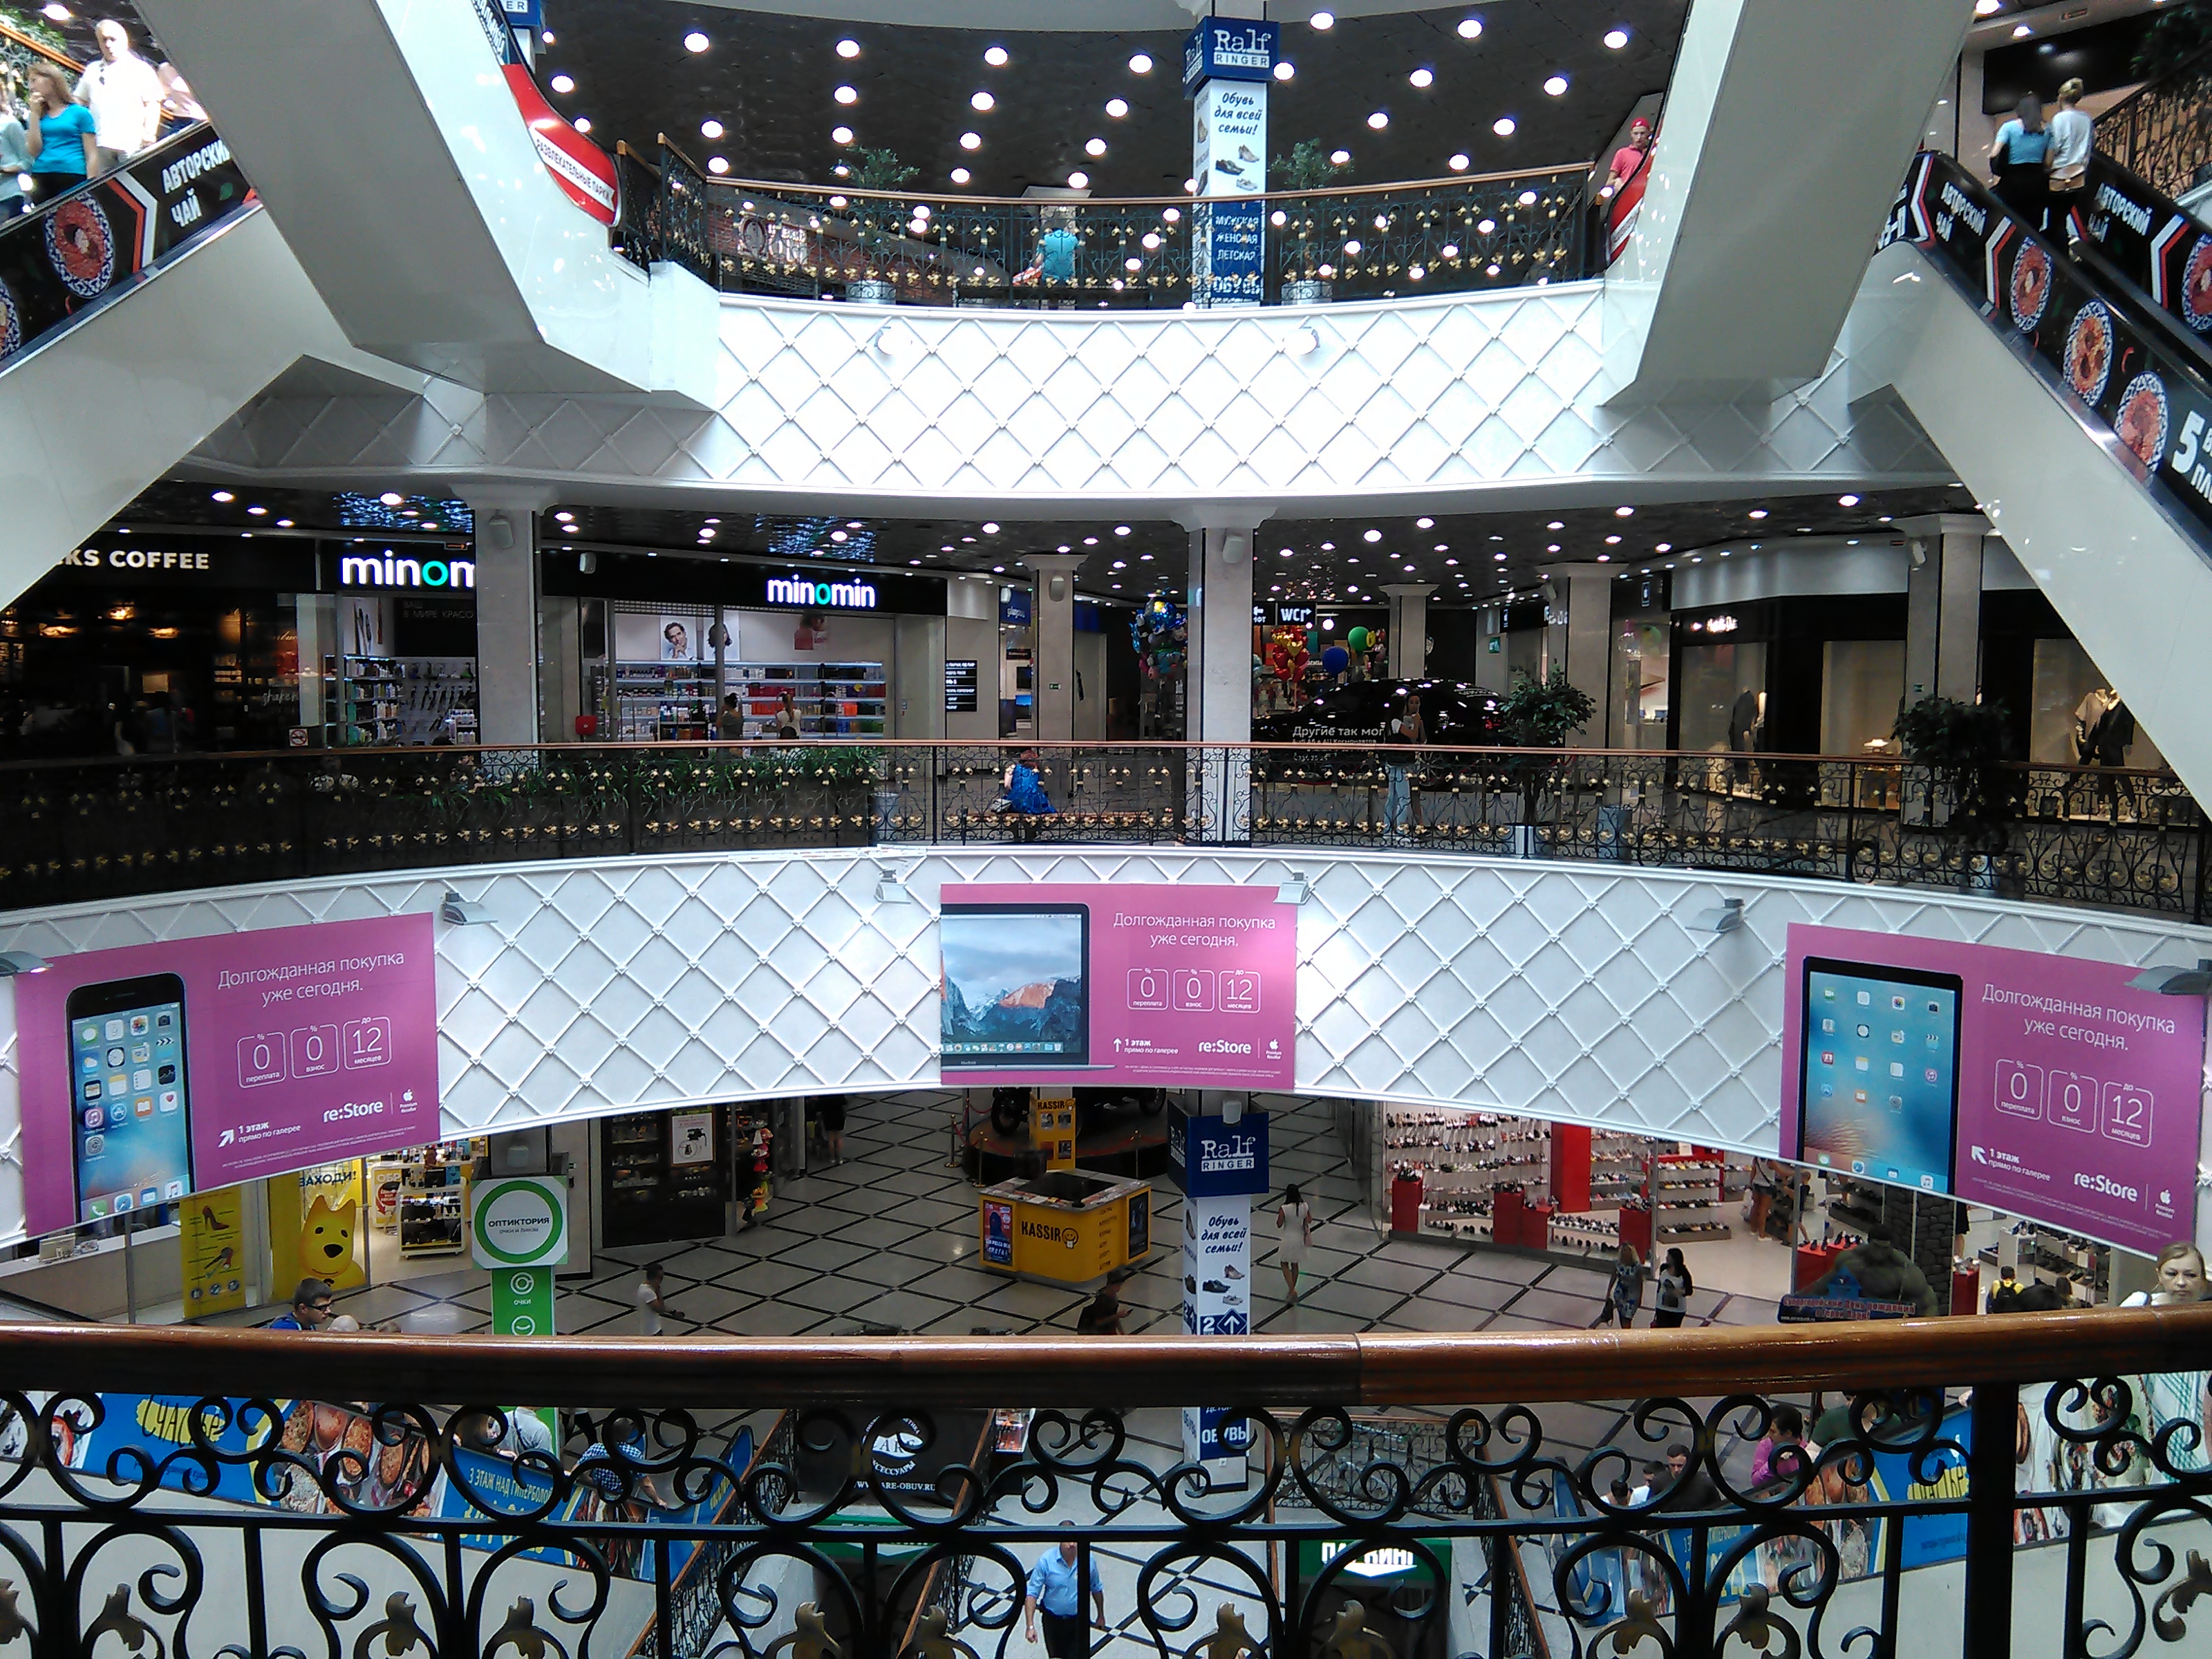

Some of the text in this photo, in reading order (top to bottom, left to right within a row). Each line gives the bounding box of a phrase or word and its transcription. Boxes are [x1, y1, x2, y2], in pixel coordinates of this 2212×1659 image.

[1214, 28, 1272, 54] Ralf
[1215, 53, 1268, 66] RINGER
[1222, 93, 1255, 106] Обувь
[1215, 106, 1263, 122] для всей
[1219, 123, 1258, 136] семьи!
[171, 187, 203, 227] ЧАЙ
[1940, 180, 1987, 236] АВТОРСКИЙ
[2094, 182, 2153, 236] АВТОРСКИЙ
[1215, 216, 1259, 227] МУЖСКАЯ
[1936, 210, 1954, 242] ЧАЙ
[2087, 213, 2110, 243] ЧАЙ
[1217, 249, 1256, 261] ДЕТСКАЯ
[2171, 410, 2206, 474] 5
[59, 549, 209, 570] KS COFFEE
[767, 574, 876, 608] minomin
[1280, 608, 1300, 621] WC
[1292, 726, 1335, 738] Другие
[1338, 728, 1358, 736] так
[1113, 912, 1276, 932] Долгожданная покупка
[1150, 934, 1239, 948] уже сегодня.
[218, 952, 404, 990] Долгожданная покупка
[261, 979, 364, 1008] уже сегодня.
[1141, 976, 1253, 1001] 0 0 12
[1982, 983, 2176, 1035] Долгожданная покупка
[361, 1016, 372, 1025] до
[1131, 1039, 1151, 1047] этаж
[2024, 1018, 2128, 1051] уже сегодня.
[253, 1027, 383, 1070] 0 0 12
[1154, 1047, 1179, 1056] галерее
[1198, 1038, 1252, 1055] re:Store
[245, 1055, 382, 1083] переплата взнос месяцев
[1038, 1100, 1065, 1110] KASSIR
[2010, 1072, 2144, 1129] 0 0 12
[323, 1100, 384, 1123] re:Store
[2000, 1100, 2141, 1141] переплата взнос месяцев
[238, 1124, 301, 1143] прямо по галерее
[245, 1121, 270, 1132] этаж
[1201, 1135, 1257, 1159] Ralf
[1203, 1159, 1253, 1170] RINGER
[1996, 1151, 2020, 1164] этаж
[299, 1170, 356, 1188] ЗАХОДИ!
[1988, 1159, 2051, 1182] прямо по галерее
[2074, 1172, 2138, 1202] re:Store
[488, 1217, 550, 1228] ОПТИКТОРИЯ
[1021, 1221, 1061, 1243] KASSIR
[1208, 1215, 1239, 1229] Обувь
[1201, 1227, 1247, 1240] для всей
[1205, 1241, 1243, 1254] семьи!
[1203, 1317, 1215, 1332] 2
[872, 1458, 917, 1476] СЕССУАРЫ
[474, 1469, 496, 1488] ЭТАЖ
[495, 1474, 512, 1499] НАД
[1322, 1542, 1414, 1566] ПКИН
